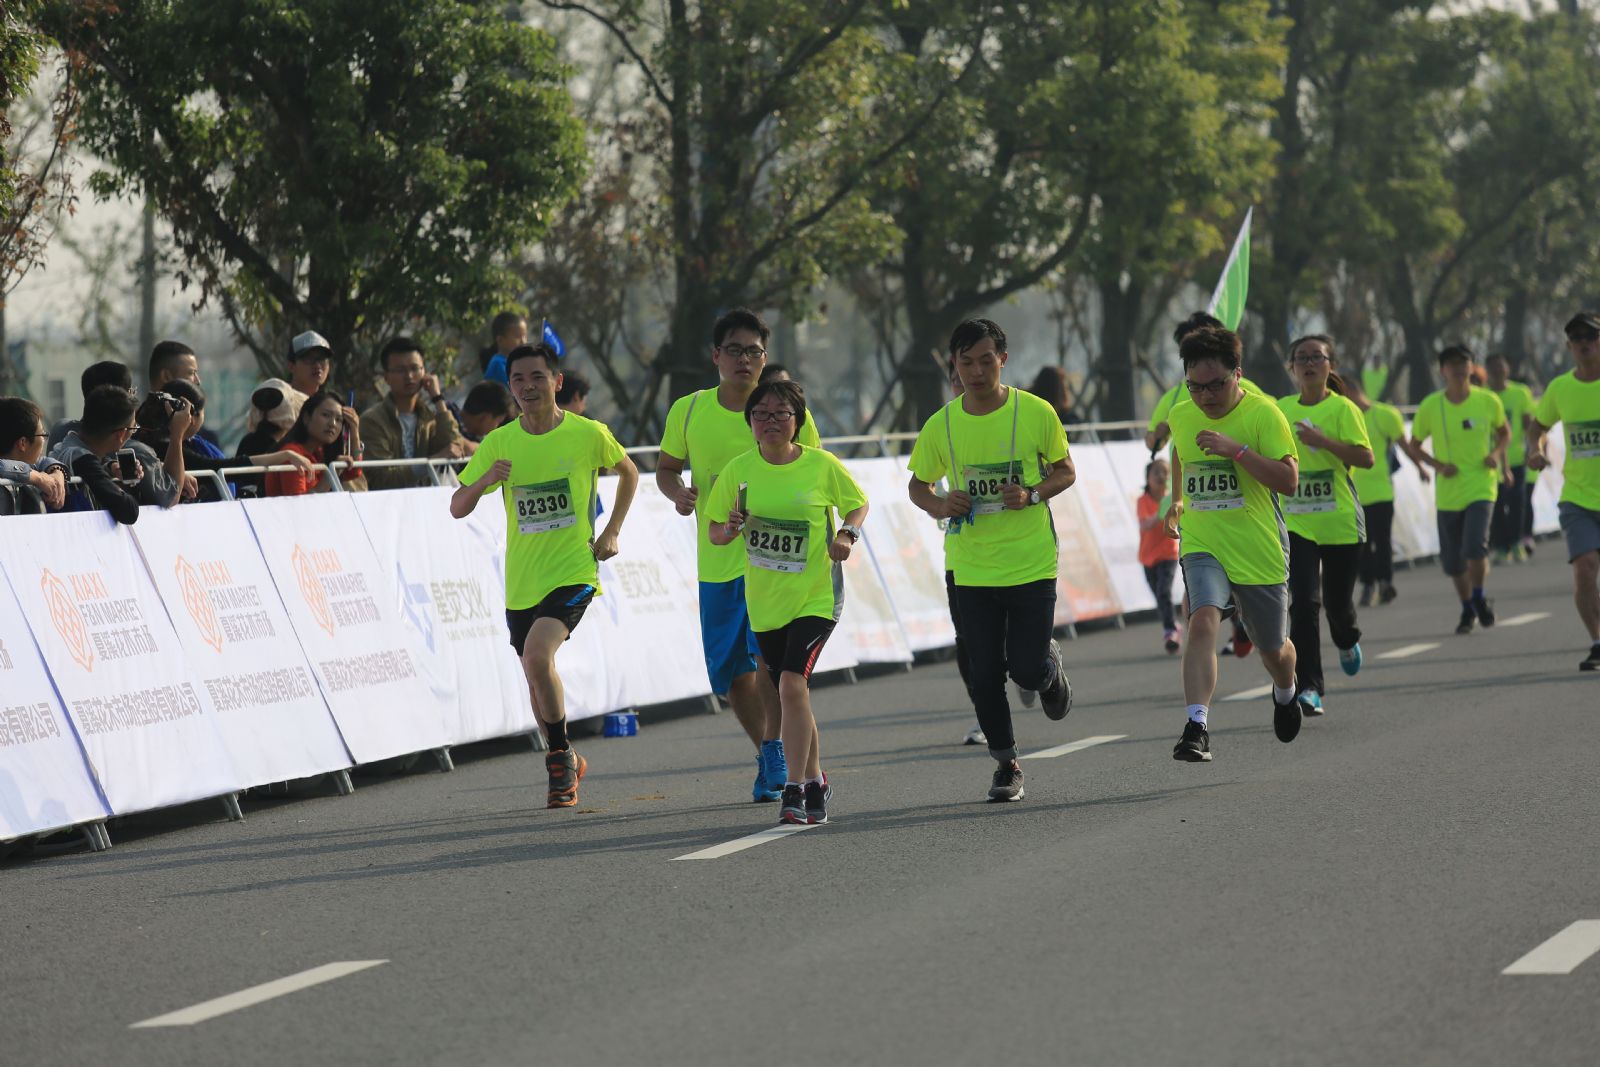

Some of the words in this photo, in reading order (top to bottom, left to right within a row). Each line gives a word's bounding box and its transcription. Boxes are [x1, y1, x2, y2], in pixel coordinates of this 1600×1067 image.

[1187, 474, 1238, 493] 81450
[1297, 481, 1332, 498] 1463
[518, 493, 568, 516] 82330
[749, 529, 804, 553] 82487
[67, 571, 109, 601] XIAXI
[198, 560, 233, 587] XIAXI
[98, 598, 143, 625] MARKET
[91, 625, 159, 661] 夏溪花木市场
[72, 682, 203, 736] 夏溪花木市场控股有限公司
